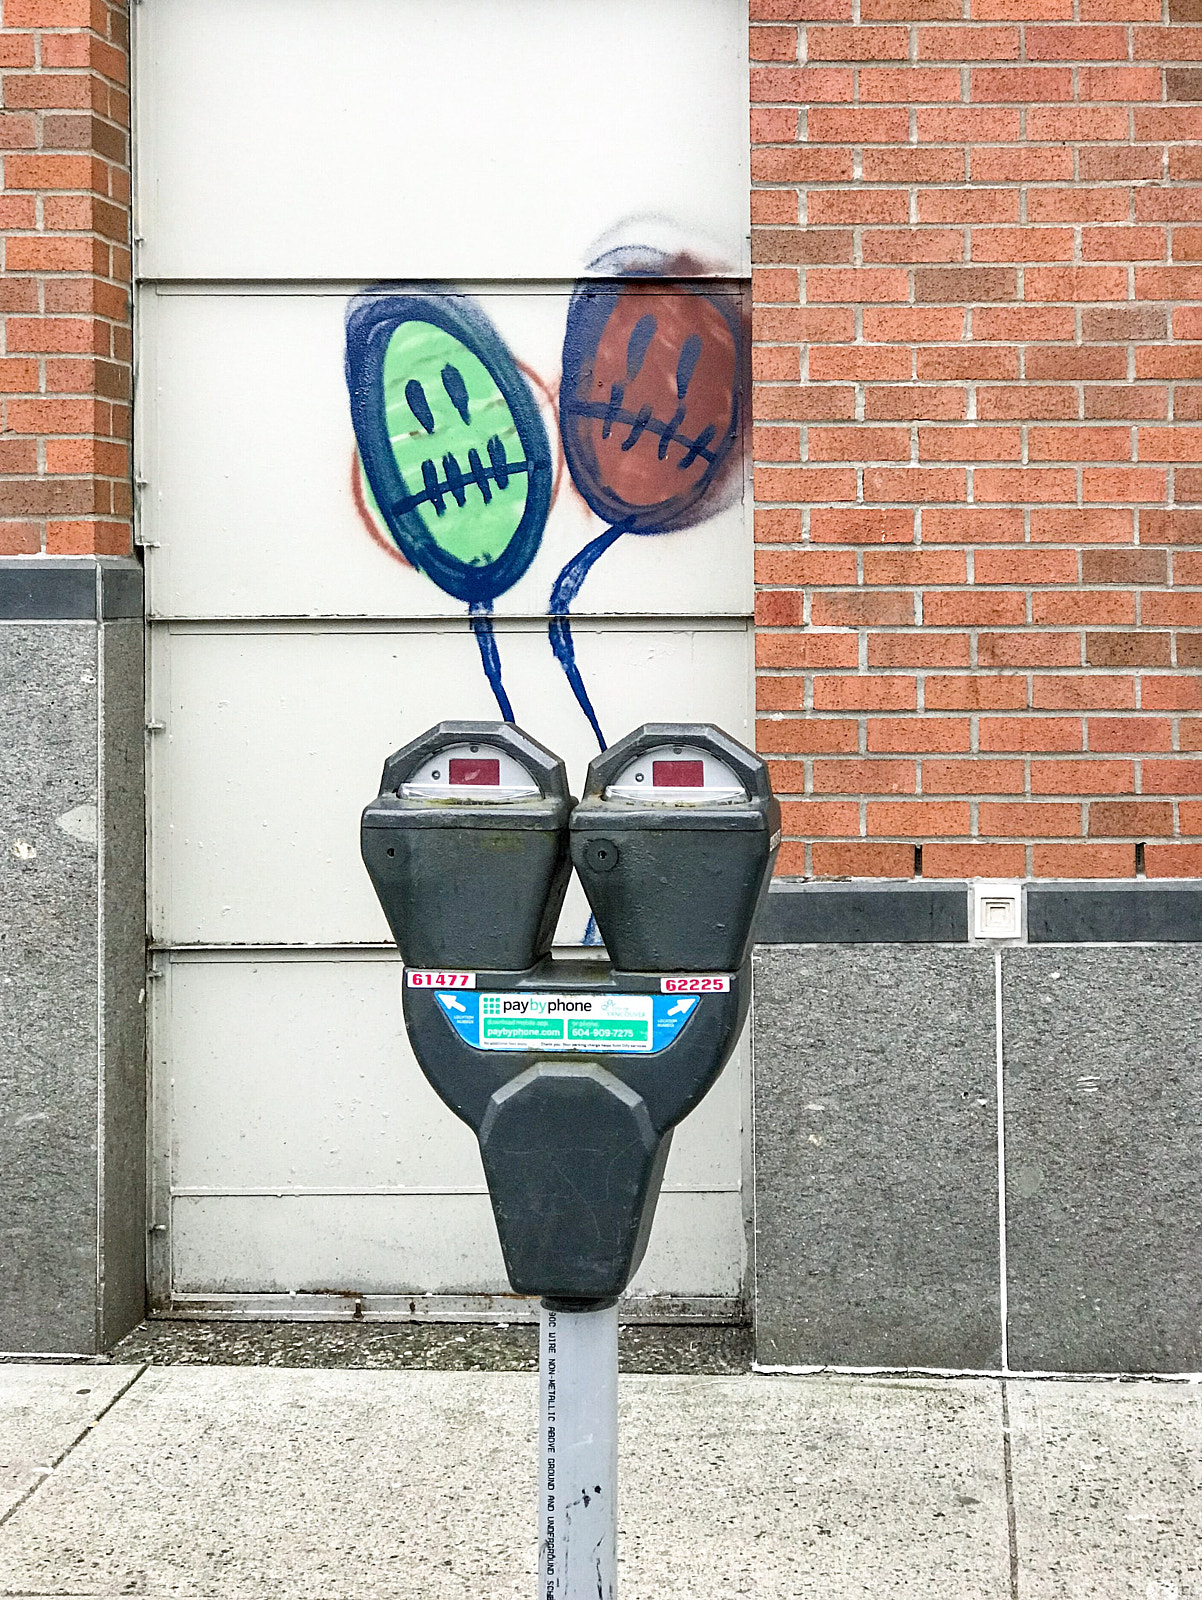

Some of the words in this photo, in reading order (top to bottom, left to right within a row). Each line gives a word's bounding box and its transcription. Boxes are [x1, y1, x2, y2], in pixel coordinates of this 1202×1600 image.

[412, 973, 469, 986] 61477
[665, 978, 724, 991] 62225
[503, 998, 592, 1014] paybyphone
[487, 1027, 560, 1037] paybyphone.com
[572, 1028, 634, 1038] 604-909-7275
[548, 1332, 557, 1354] WIRE
[547, 1358, 556, 1422] NON-METALLIC
[547, 1426, 556, 1453] ABOVE
[547, 1458, 556, 1491] GROUND
[547, 1495, 555, 1512] AND
[546, 1516, 555, 1576] UNDERGROUND
